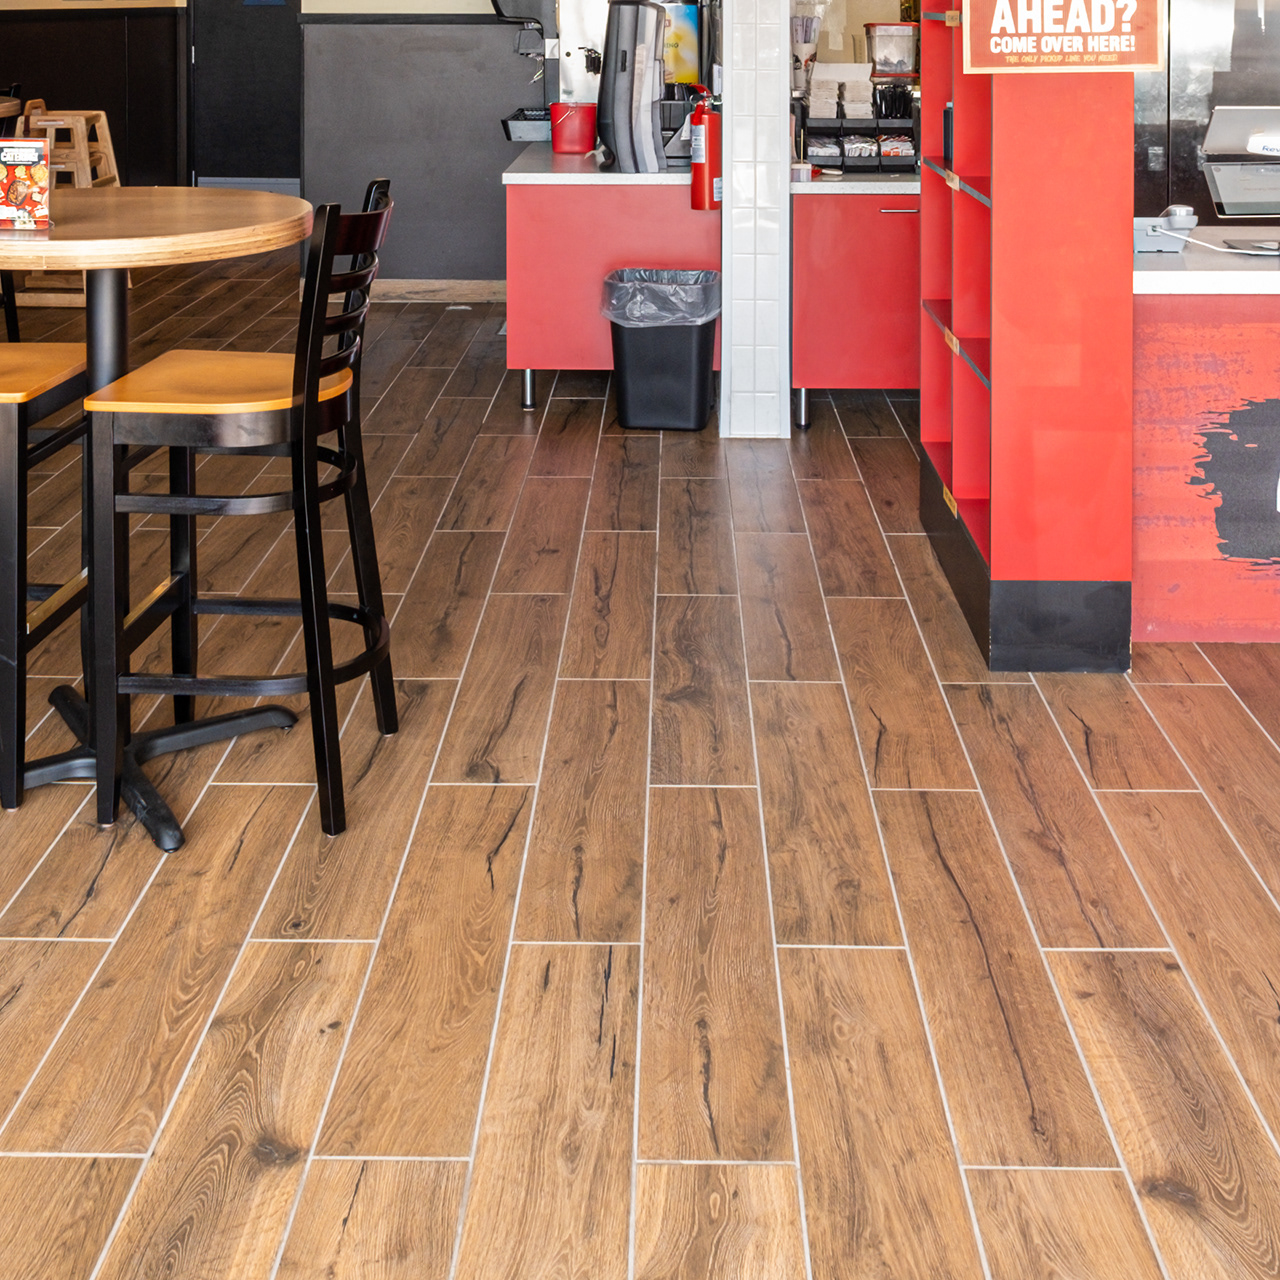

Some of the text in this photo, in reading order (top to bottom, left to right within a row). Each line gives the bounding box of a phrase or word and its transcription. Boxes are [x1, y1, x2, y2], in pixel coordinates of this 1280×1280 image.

[990, 35, 1136, 53] COME OVER HERE!
